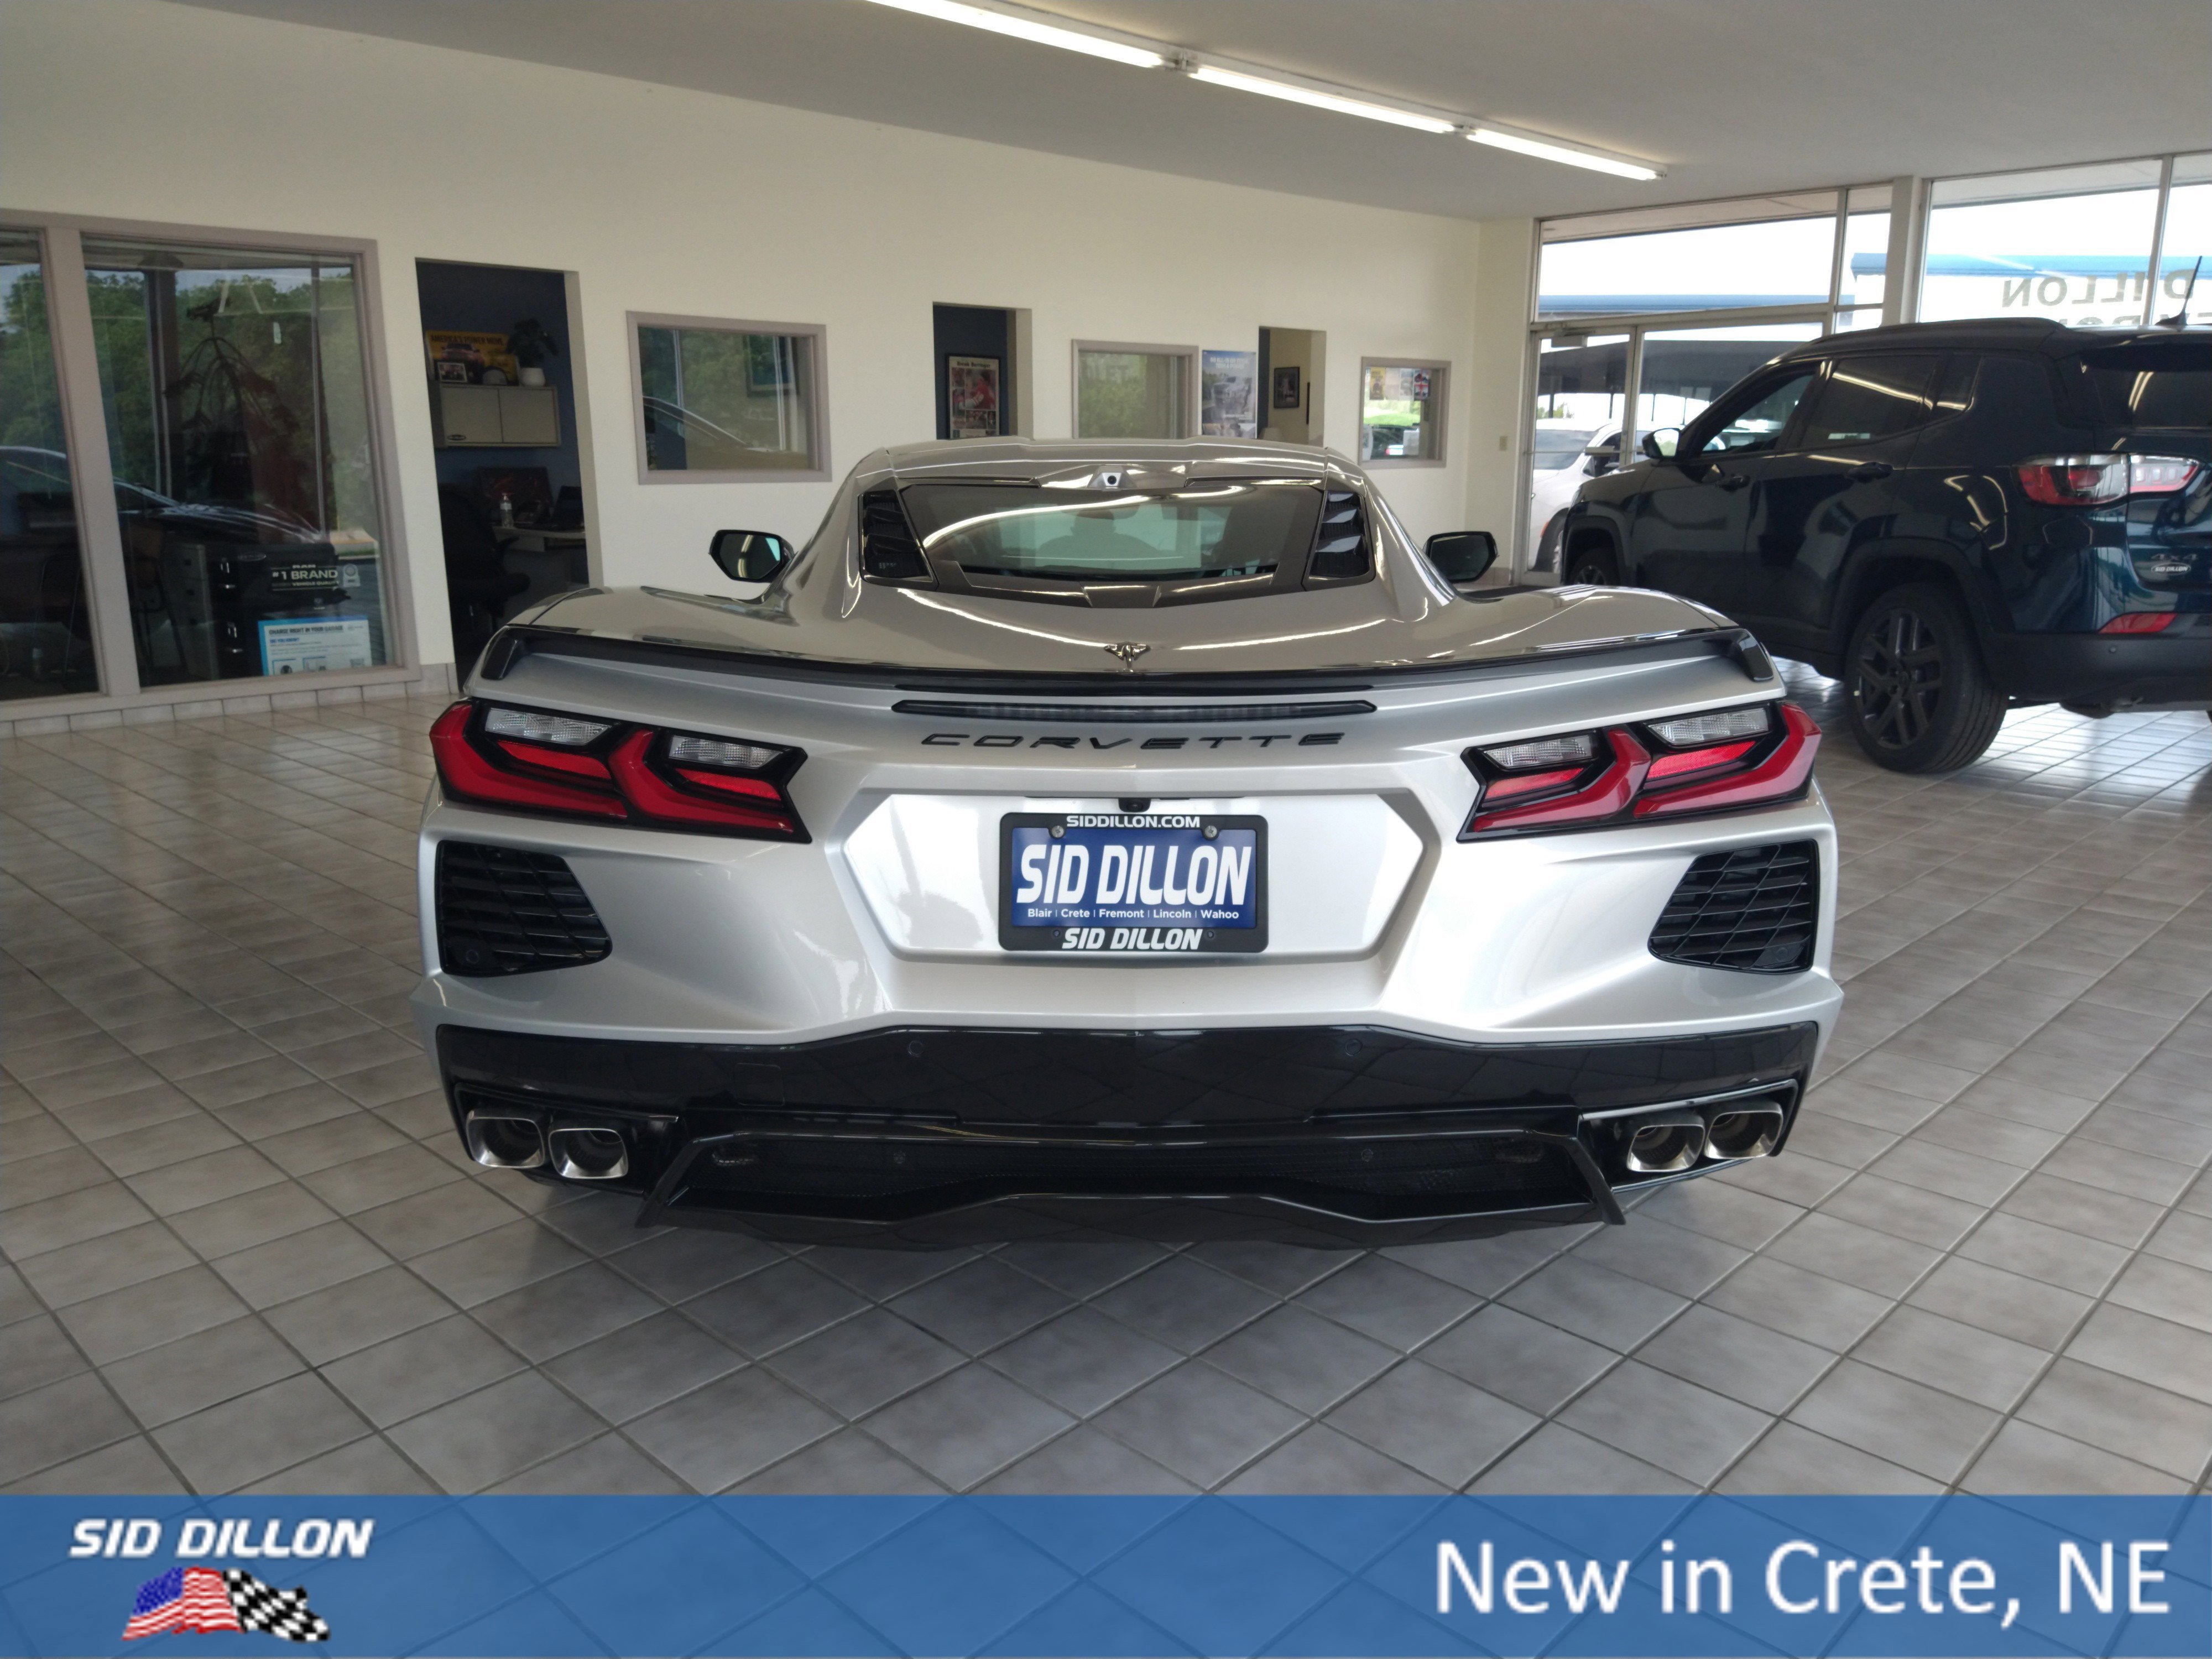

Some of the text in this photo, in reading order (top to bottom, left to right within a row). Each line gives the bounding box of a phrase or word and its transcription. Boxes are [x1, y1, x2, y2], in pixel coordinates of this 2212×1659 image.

[291, 570, 338, 580] BRAND
[921, 732, 1345, 750] CORVETTE
[1066, 815, 1200, 828] SIDDILLON.COM
[1016, 844, 1252, 906] SID DILLON
[1027, 909, 1239, 919] Blair Crete Fremont Lincoln Wahoo
[1062, 928, 1203, 950] SID DILLON
